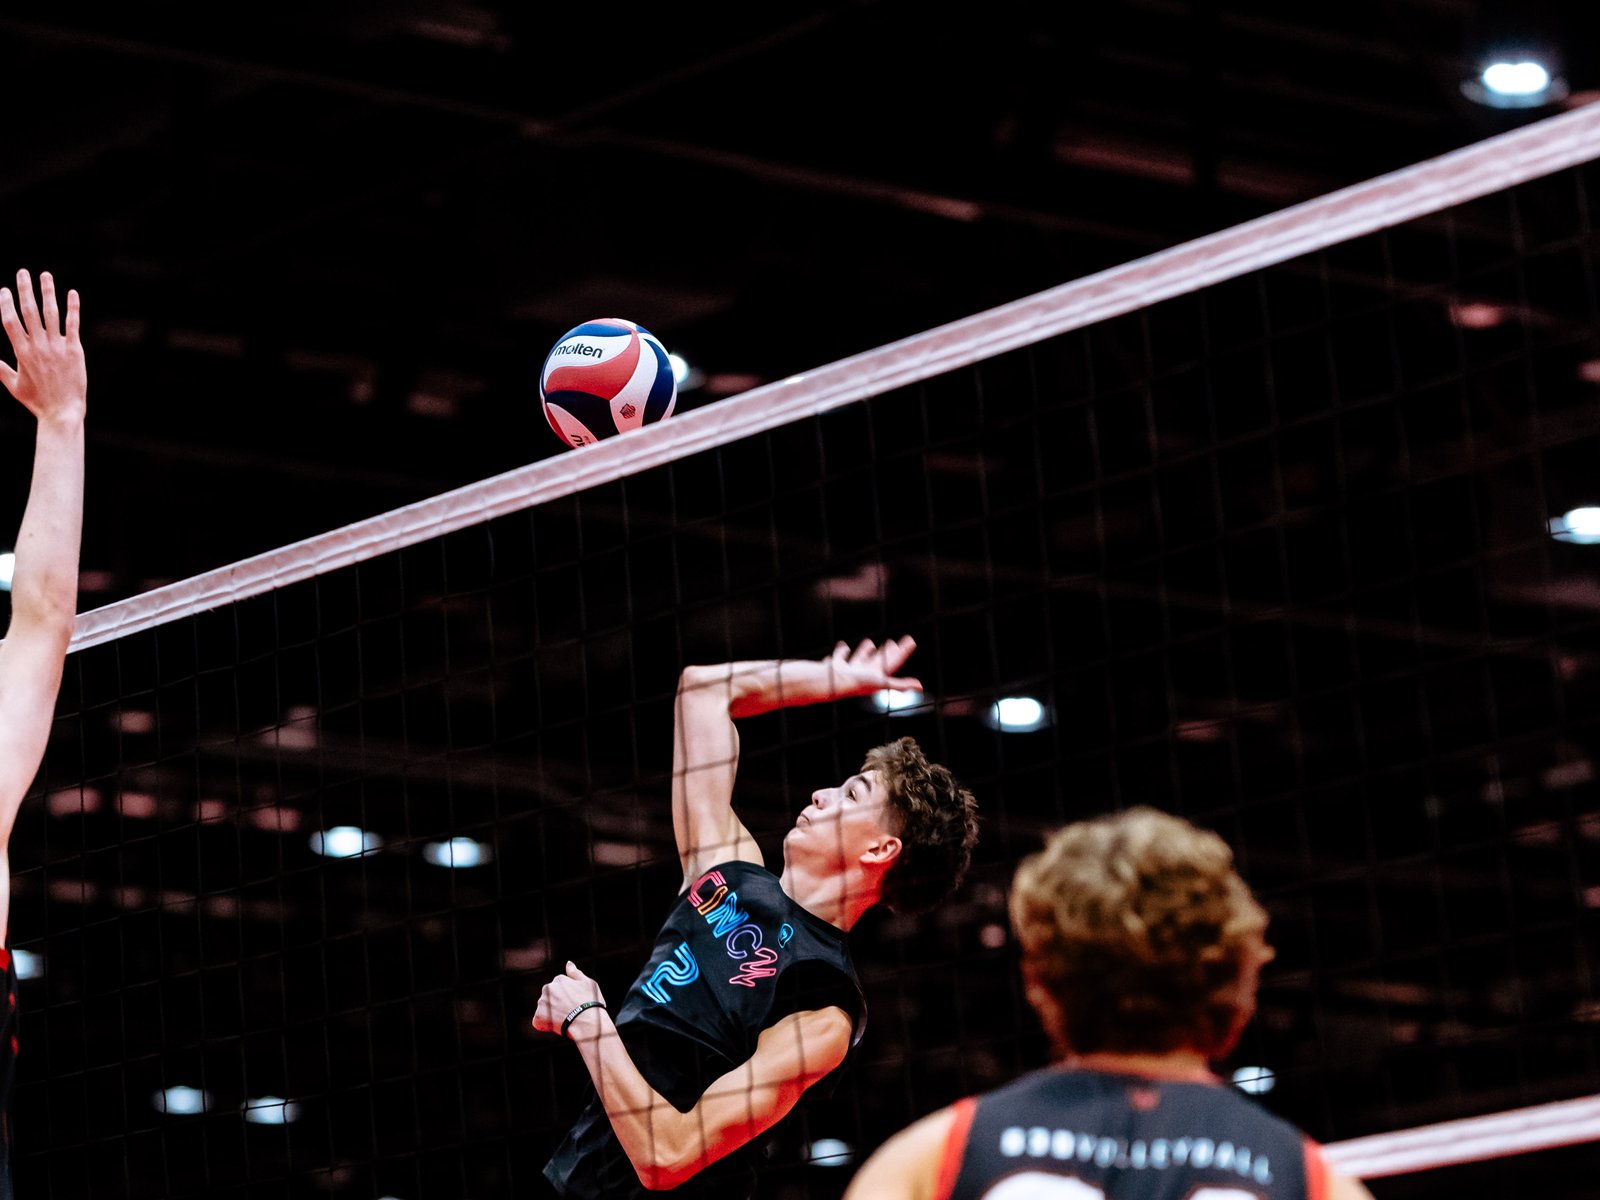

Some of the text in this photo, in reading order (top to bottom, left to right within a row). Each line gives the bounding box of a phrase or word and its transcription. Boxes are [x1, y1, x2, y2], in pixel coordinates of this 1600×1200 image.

[554, 342, 603, 359] molten
[687, 870, 779, 988] CINCY
[640, 941, 701, 1004] 2
